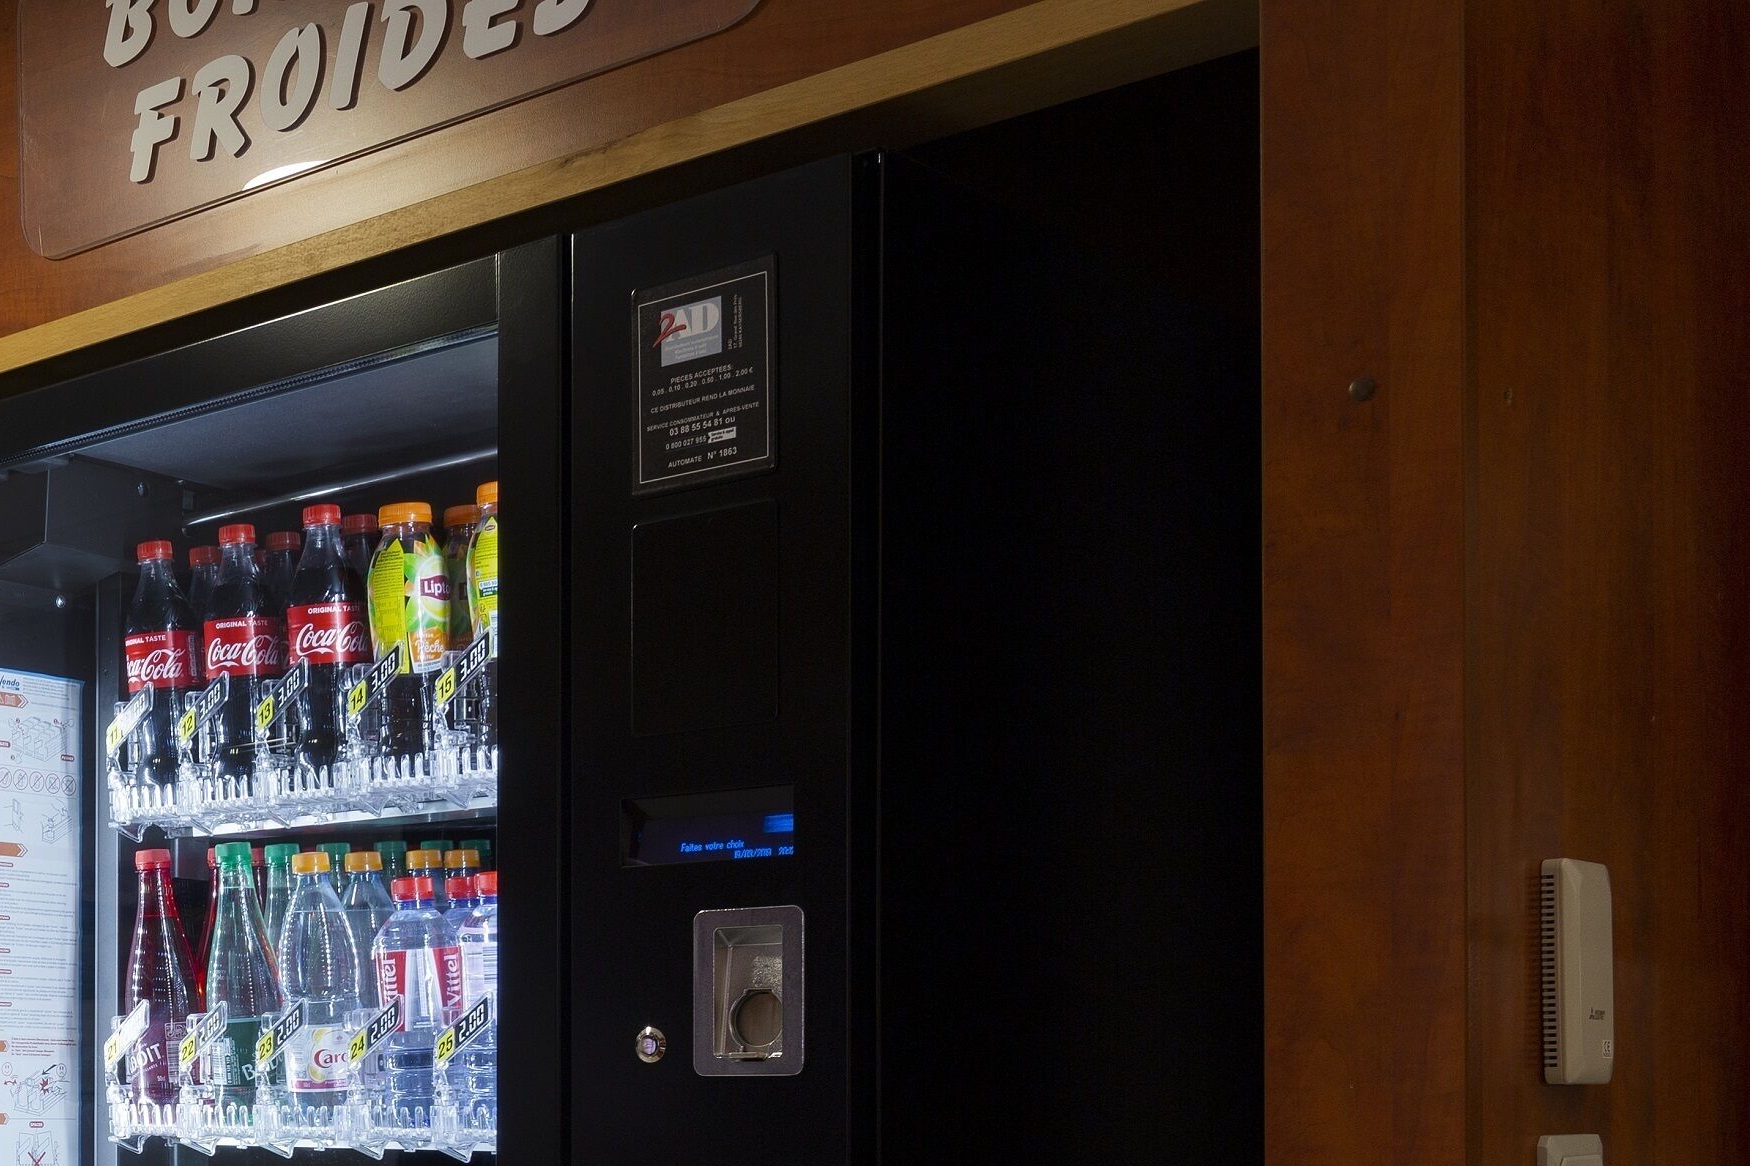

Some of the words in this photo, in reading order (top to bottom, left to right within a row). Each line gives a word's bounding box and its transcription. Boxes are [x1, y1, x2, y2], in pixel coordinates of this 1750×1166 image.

[671, 374, 692, 384] PIECES
[736, 369, 748, 377] 2.00
[660, 397, 700, 412] DISTRIBUTEUR
[702, 393, 718, 402] REND
[728, 384, 755, 396] MONNAIE
[670, 428, 678, 436] 03
[692, 423, 700, 431] 55
[703, 420, 712, 428] 54
[714, 418, 723, 426] 81
[668, 455, 702, 468] AUTOMATE
[719, 446, 737, 457] 1863
[216, 620, 247, 630] ORIGINAL
[308, 605, 341, 615] ORIGINAL
[208, 634, 279, 669] Coca-Cola
[439, 677, 452, 698] 15
[460, 639, 485, 681] 3.00
[259, 703, 271, 723] 13
[278, 669, 300, 708] 3.00
[351, 690, 363, 710] 14
[371, 652, 396, 693] 3.00
[182, 717, 193, 734] 12
[200, 683, 220, 719] 3.00
[680, 843, 702, 853] Faites
[705, 842, 724, 851] votre
[727, 840, 744, 848] choix
[182, 1040, 194, 1061] 22
[200, 1013, 219, 1044] 2.00
[259, 1039, 272, 1061] 23
[277, 1007, 300, 1044] 2.00
[350, 1038, 364, 1061] 24
[371, 1005, 396, 1044] 2.00
[438, 1036, 453, 1059] 25
[458, 1004, 484, 1042] 2.00
